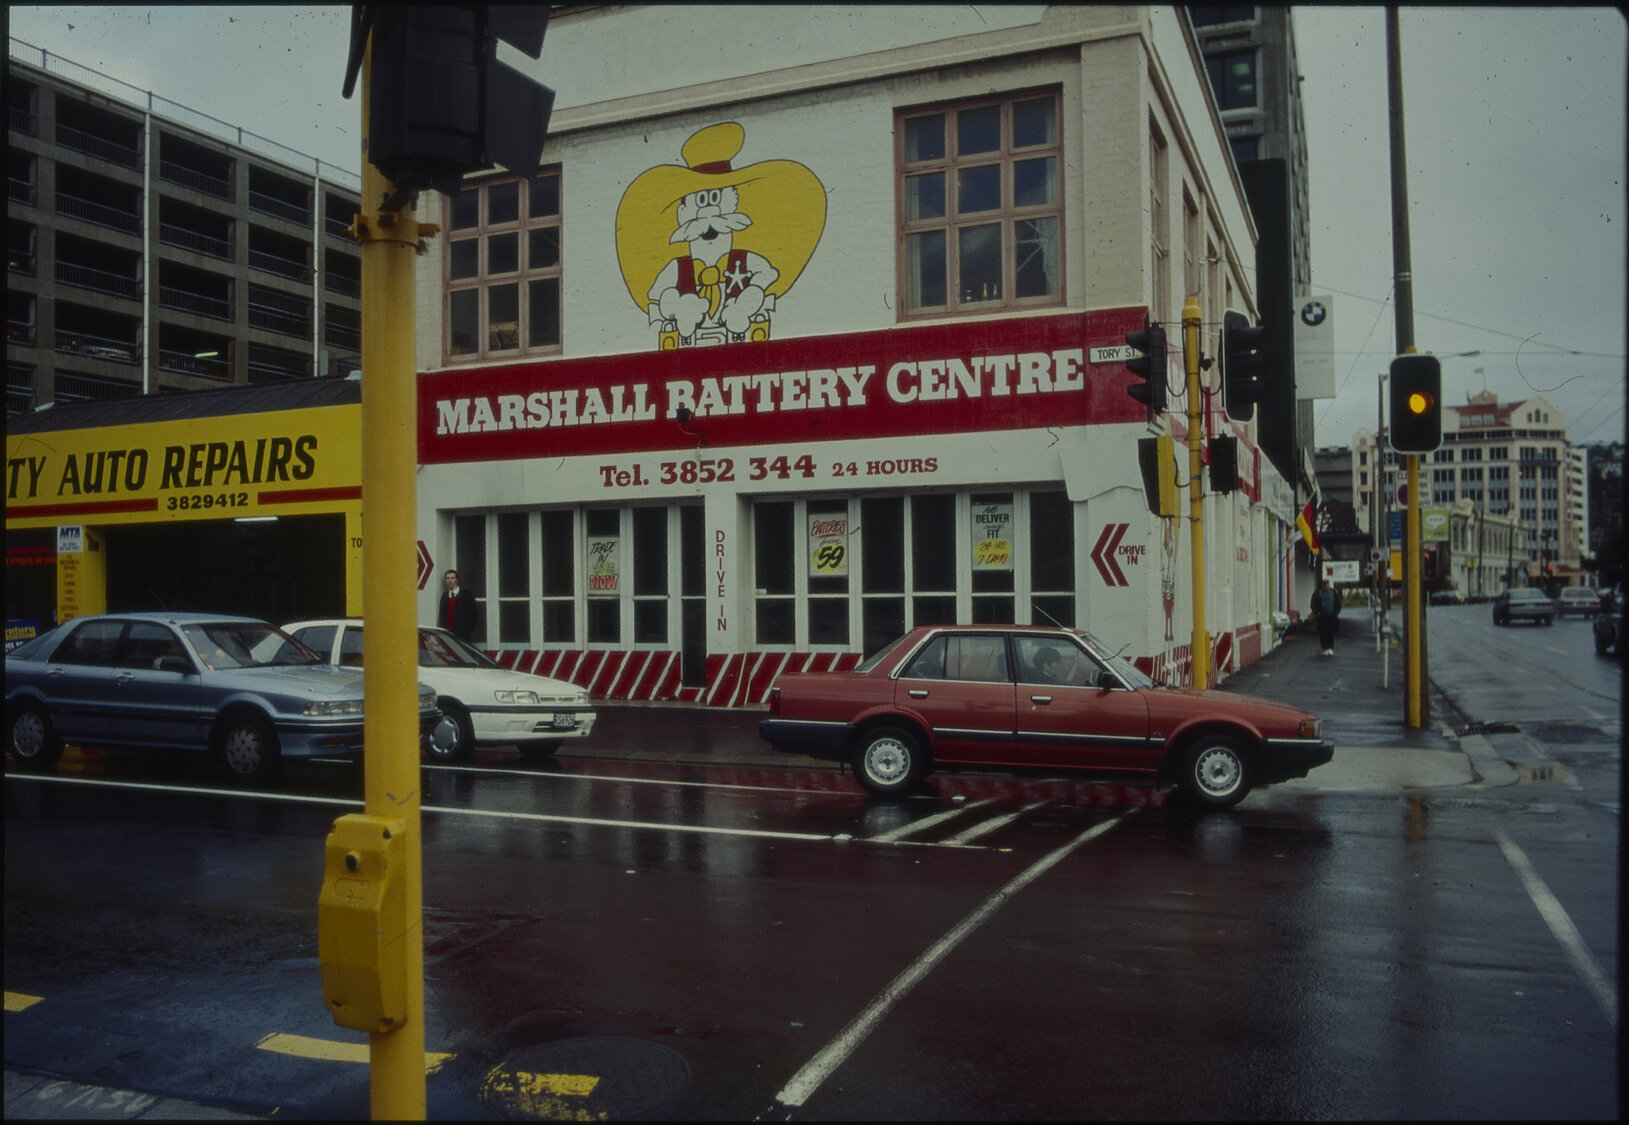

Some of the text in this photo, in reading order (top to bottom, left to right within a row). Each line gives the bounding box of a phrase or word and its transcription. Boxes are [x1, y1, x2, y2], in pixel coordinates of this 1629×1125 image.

[1097, 348, 1120, 360] TORY
[436, 348, 1085, 436] MARSHALL BATTERY CENTRE
[57, 448, 149, 496] AUTO
[160, 434, 318, 490] REPAIRS
[600, 455, 938, 488] Tel. 3852 344 24 HOURS
[166, 492, 249, 511] 3829412
[976, 514, 1009, 524] DELIVER
[60, 526, 80, 538] MTA
[811, 520, 846, 536] BATTERIES
[987, 530, 999, 539] FIT
[590, 541, 618, 555] TRADE
[1118, 545, 1146, 556] DRIVE
[817, 546, 844, 569] 59
[1127, 555, 1138, 565] IN
[590, 573, 619, 590] NOW
[716, 530, 727, 631] DRIVE IN
